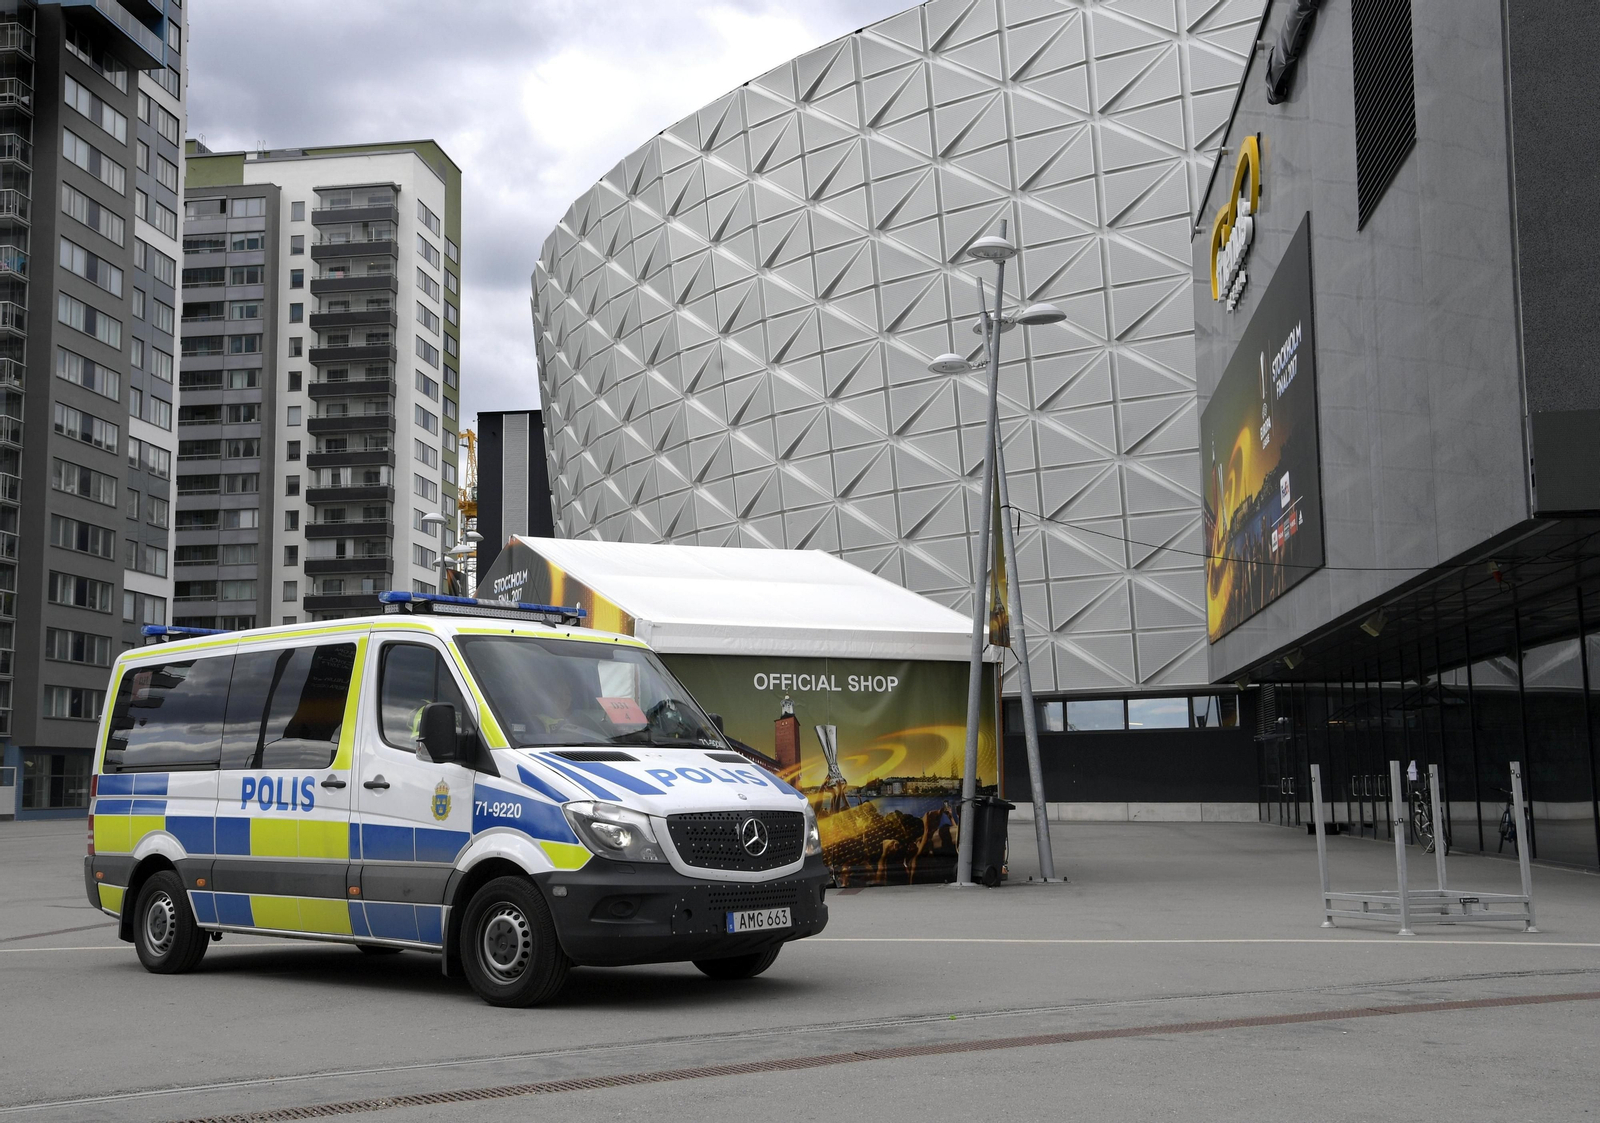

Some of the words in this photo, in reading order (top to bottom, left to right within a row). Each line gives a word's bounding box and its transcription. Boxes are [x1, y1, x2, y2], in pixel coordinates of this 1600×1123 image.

[1271, 319, 1301, 382] STOCKHOLM
[512, 588, 522, 602] 2017
[754, 673, 842, 691] OFFICIAL
[848, 675, 899, 692] SHOP
[644, 767, 768, 787] POLIS
[241, 776, 315, 812] POLIS
[475, 801, 522, 818] 71-9220
[740, 912, 764, 929] AMG
[767, 910, 788, 926] 663
